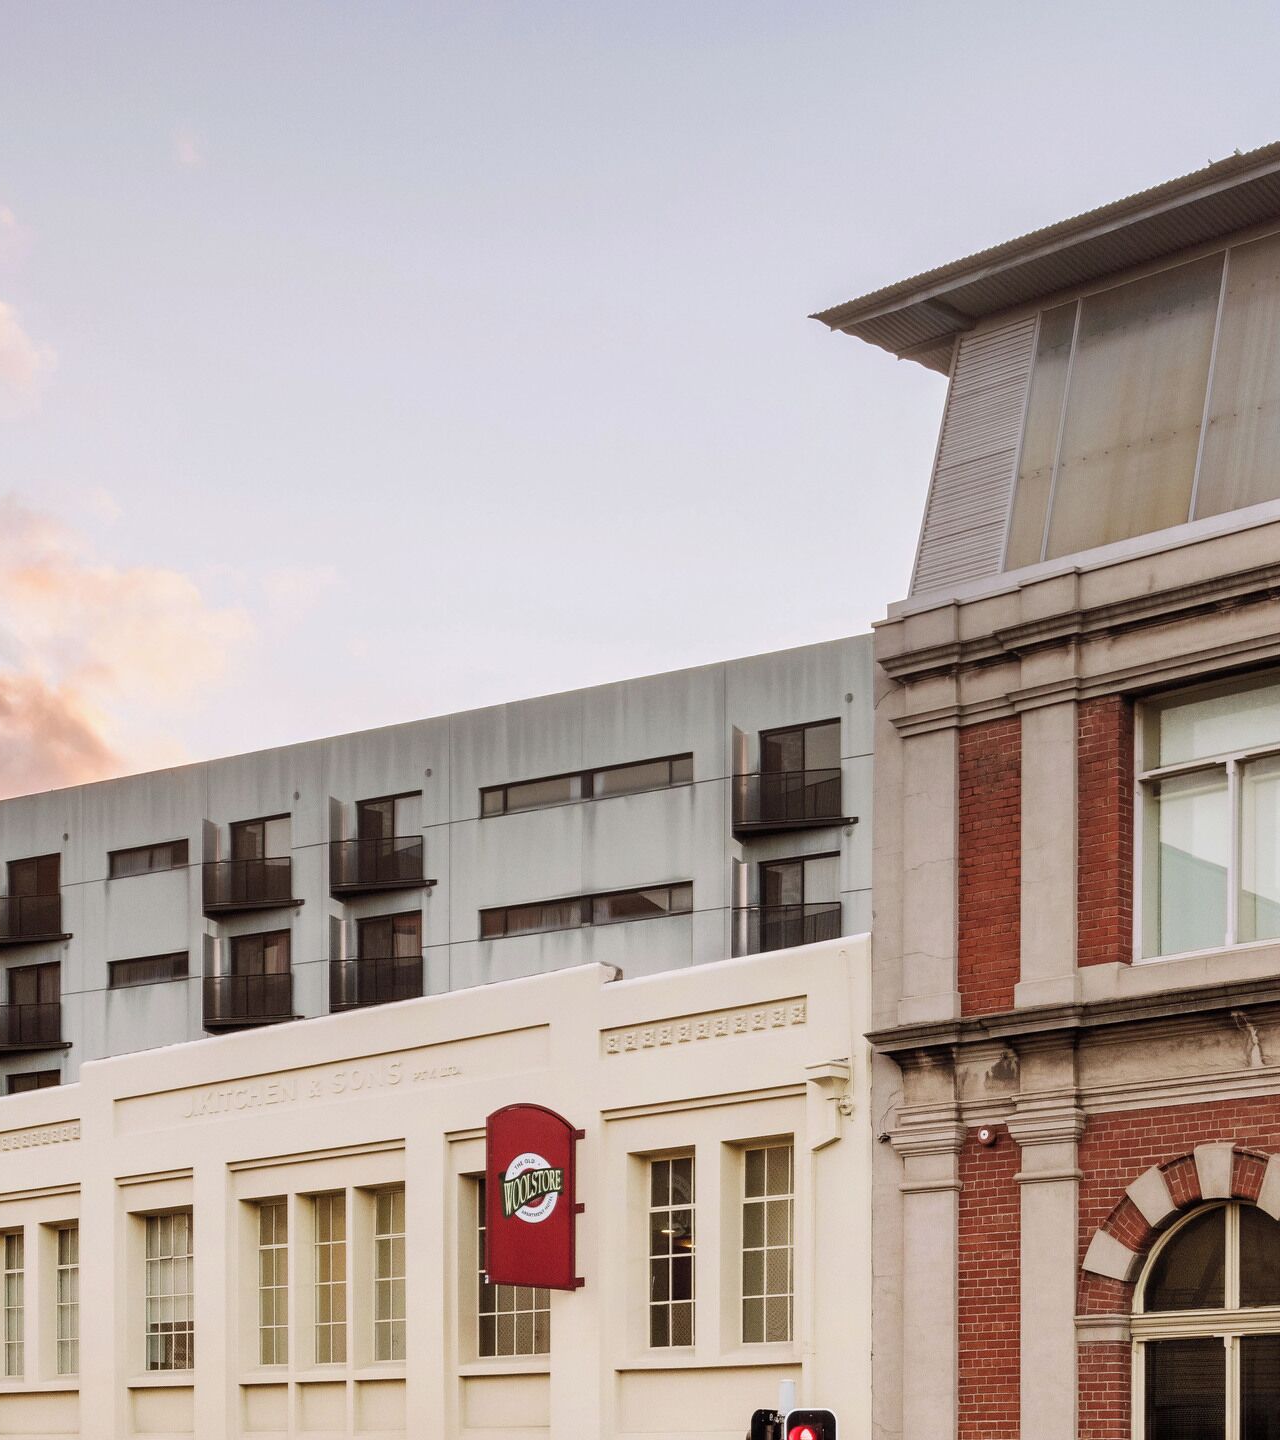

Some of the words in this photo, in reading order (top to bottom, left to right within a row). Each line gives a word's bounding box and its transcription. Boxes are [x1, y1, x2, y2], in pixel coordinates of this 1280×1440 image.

[309, 1080, 321, 1099] &
[332, 1062, 403, 1095] SONS
[514, 1161, 523, 1170] THE
[503, 1170, 561, 1216] WOOLSTORE
